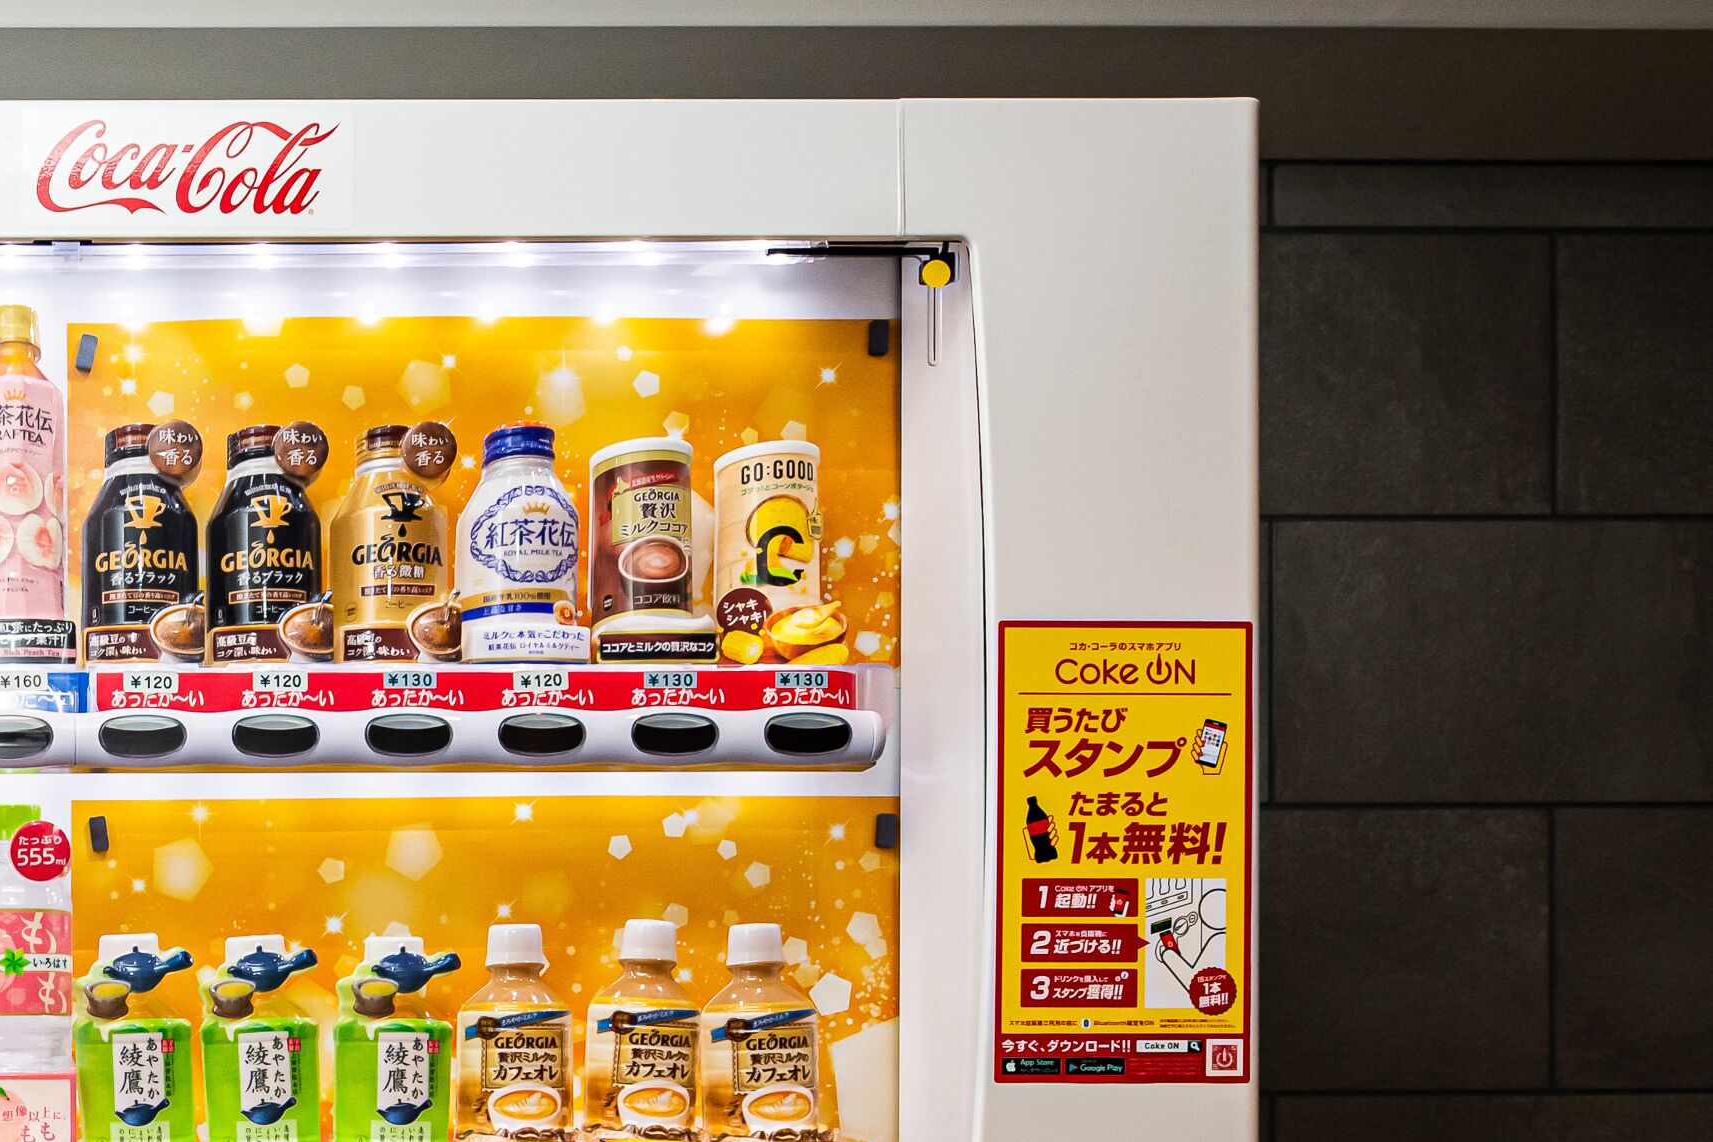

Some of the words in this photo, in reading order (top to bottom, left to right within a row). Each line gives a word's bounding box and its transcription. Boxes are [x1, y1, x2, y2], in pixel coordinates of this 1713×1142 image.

[37, 119, 340, 215] Coca-Cola
[159, 429, 199, 444] 味わい
[283, 429, 323, 444] 味わい
[411, 432, 449, 447] 味わい
[162, 448, 194, 466] 香る
[286, 449, 317, 466] 香る
[415, 451, 445, 467] 香る
[640, 503, 676, 519] 贅沢
[485, 518, 577, 550] 紅茶花伝
[504, 549, 530, 558] ROYAL
[532, 549, 549, 557] MILK
[551, 549, 563, 557] TEA
[22, 648, 45, 658] Peach
[48, 648, 60, 657] Tea
[1070, 642, 1181, 651] コカ・コーラのスマホアプリ
[1055, 659, 1139, 685] Coke
[1147, 653, 1196, 685] ON
[0, 675, 42, 688] ¥160
[131, 676, 172, 689] ¥120
[260, 675, 302, 688] ¥120
[388, 674, 432, 687] ¥130
[521, 674, 562, 688] ¥120
[648, 674, 693, 687] ¥130
[780, 673, 824, 686] ¥130
[1025, 707, 1128, 734] 買うたび
[1023, 736, 1187, 779] スタンプ
[1068, 792, 1168, 817] たまると
[18, 835, 63, 846] たっぷり
[1068, 822, 1227, 865] 1本無料!
[1054, 894, 1096, 909] 起動!!
[1054, 939, 1121, 955] 近づける!!
[1053, 984, 1123, 1000] スタンプ獲得!!
[1002, 1039, 1131, 1053] 今すぐ、ダウンロード!!
[1144, 1042, 1166, 1050] Coke
[1168, 1042, 1180, 1050] ON
[118, 1044, 144, 1095] 綾鷹
[245, 1045, 272, 1094] 綾鷹
[383, 1046, 410, 1094] 綾鷹
[493, 1066, 560, 1082] カフェオレ
[625, 1064, 690, 1081] カフェオレ
[745, 1066, 811, 1084] カフェオレ
[1080, 1063, 1105, 1073] Google
[1107, 1063, 1123, 1073] Play
